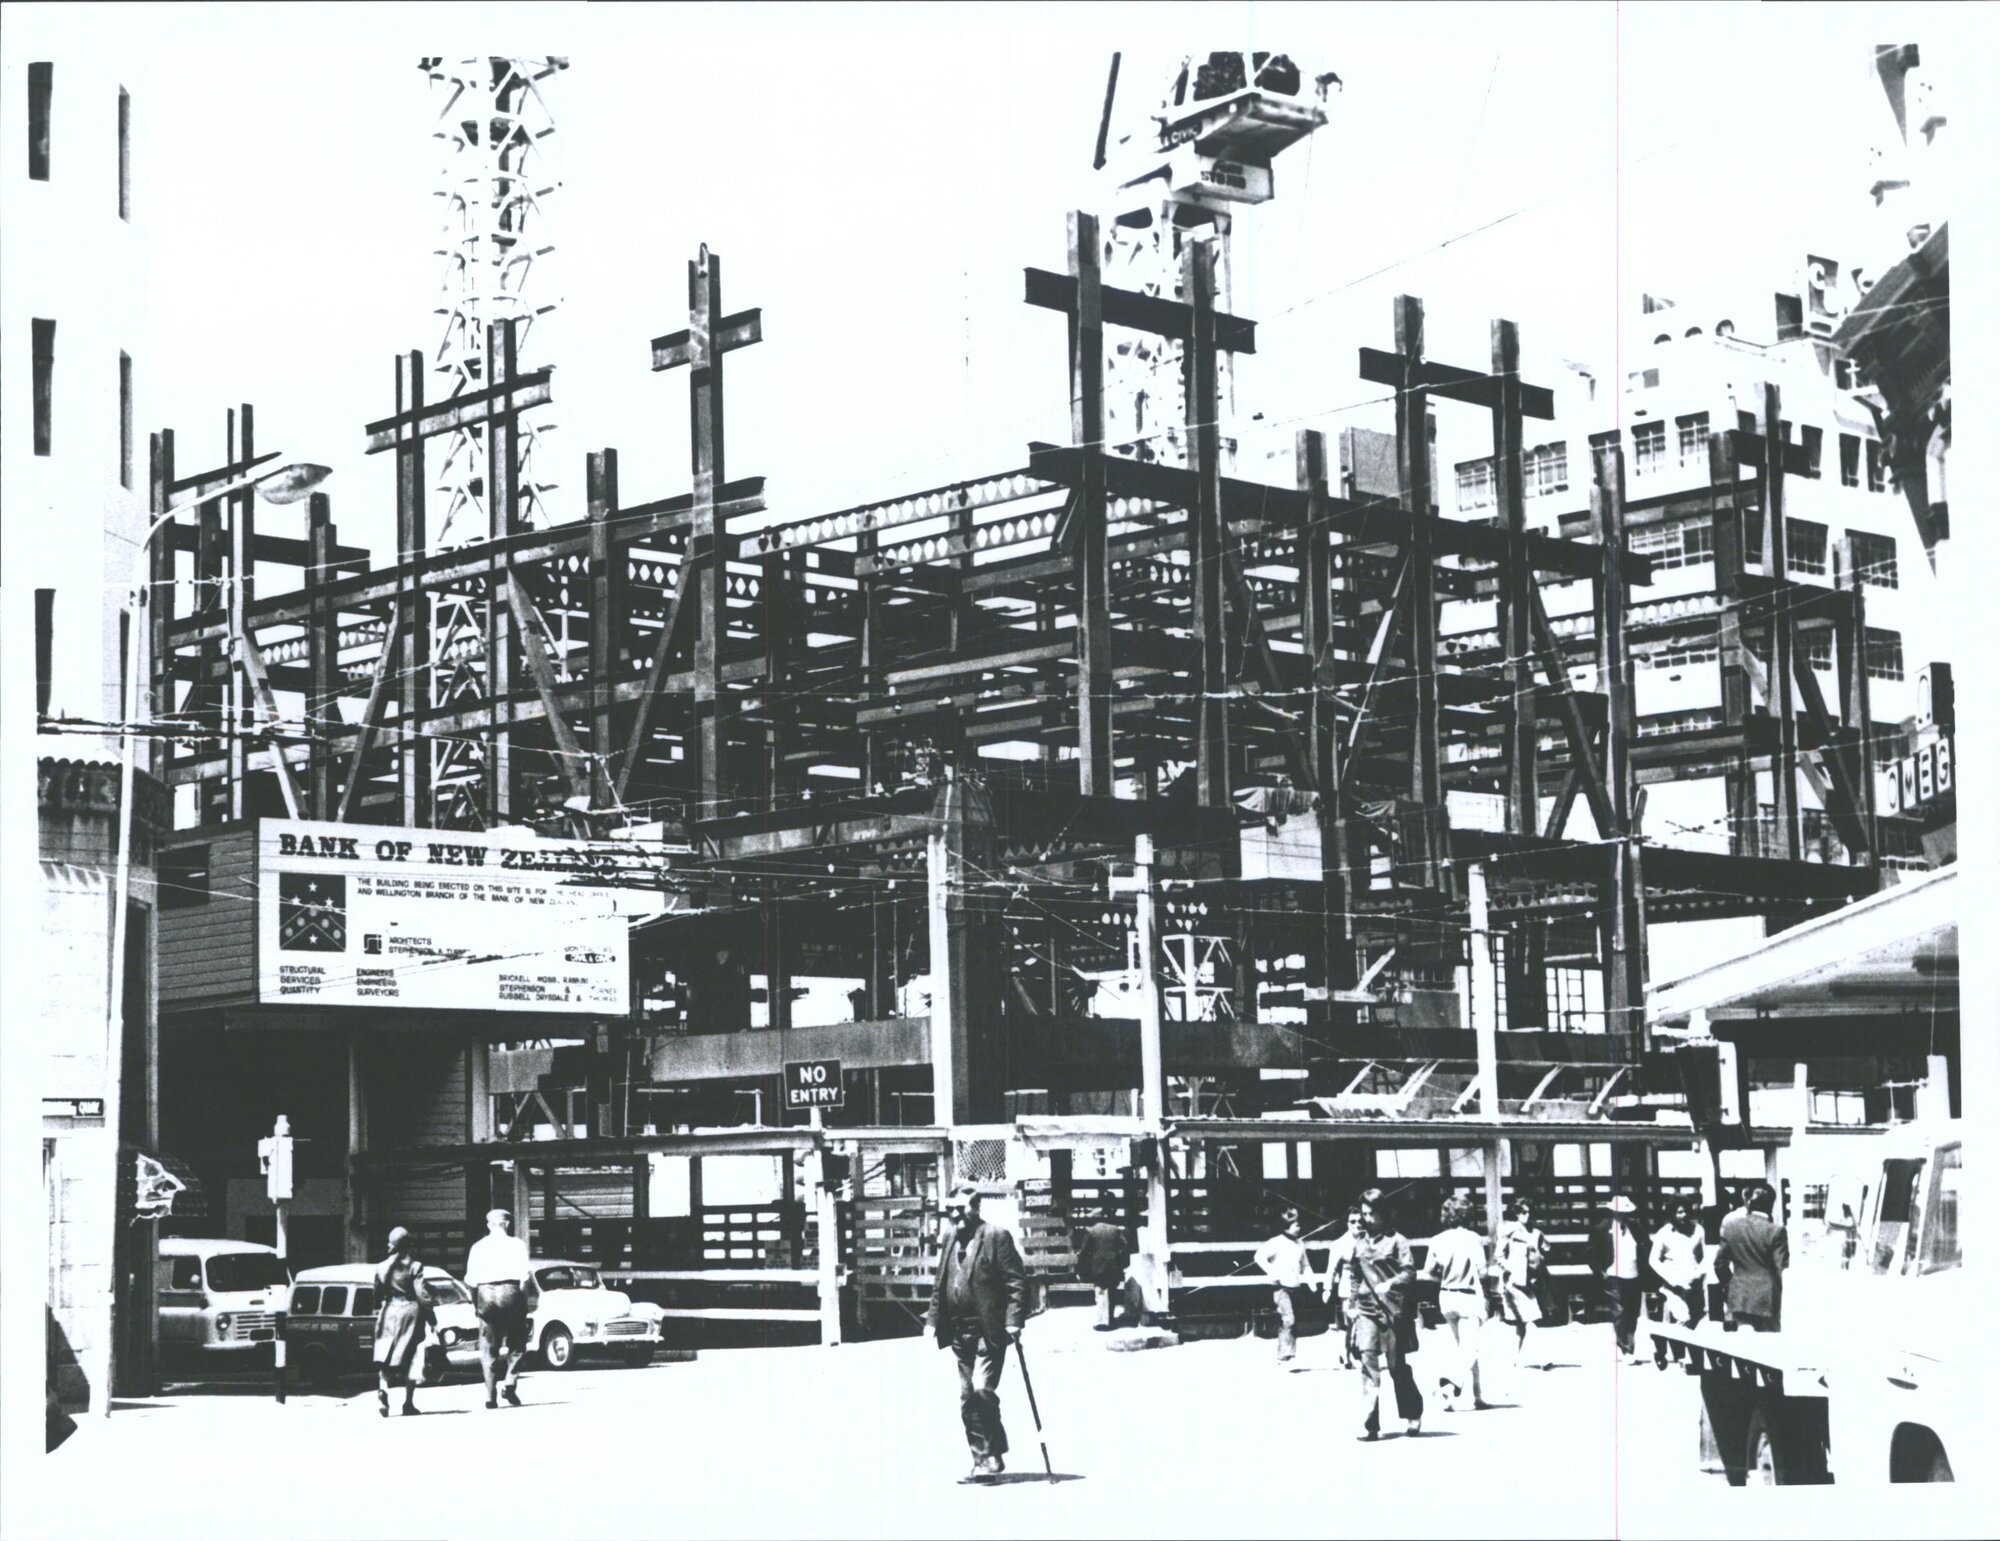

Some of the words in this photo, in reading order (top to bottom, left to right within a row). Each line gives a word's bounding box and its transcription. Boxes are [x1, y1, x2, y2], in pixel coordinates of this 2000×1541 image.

[279, 833, 360, 859] BANK
[375, 840, 412, 861] OF
[427, 843, 488, 867] NEW
[357, 877, 371, 886] THE
[376, 879, 409, 888] BUILDING
[414, 880, 435, 889] BEING
[438, 882, 469, 891] ERECTED
[473, 883, 485, 892] ON
[488, 884, 504, 893] THIS
[506, 886, 522, 894] SITE
[525, 887, 532, 895] IS
[357, 888, 373, 896] AND
[375, 889, 422, 898] WELLINGTON
[426, 891, 455, 900] BRANCH
[459, 893, 468, 901] OF
[473, 893, 486, 901] THE
[491, 894, 510, 903] BANK
[514, 896, 524, 904] OF
[529, 897, 545, 905] NEW
[389, 937, 433, 946] ARCHITECTS
[279, 965, 326, 975] STRUCTURAL
[280, 975, 321, 985] SERVICES
[499, 974, 531, 982] BRICKELL
[279, 985, 321, 995] QUANTITY
[357, 988, 399, 997] SURVEYORS
[499, 984, 545, 992] STEPHENSON
[799, 1065, 827, 1084] NO
[790, 1086, 839, 1104] ENTRY
